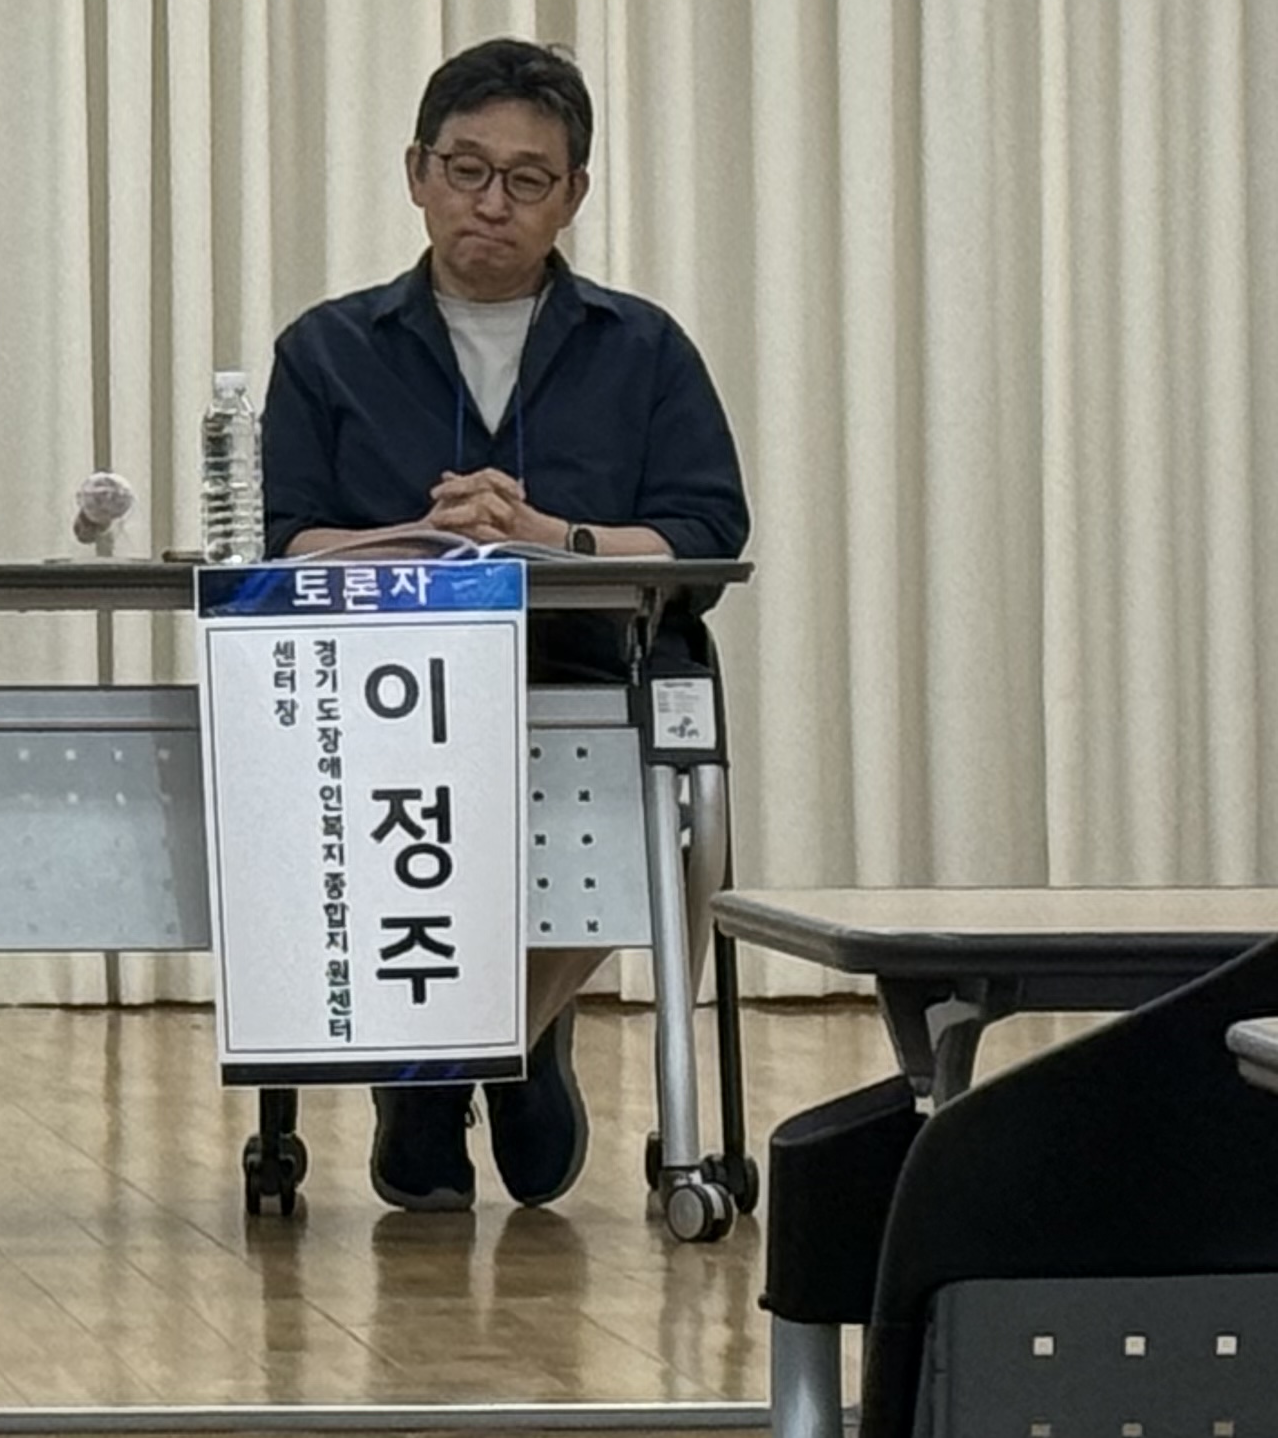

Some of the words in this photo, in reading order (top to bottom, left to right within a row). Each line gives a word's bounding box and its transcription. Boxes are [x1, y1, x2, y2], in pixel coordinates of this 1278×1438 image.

[293, 566, 431, 610] 토론자
[273, 640, 298, 726] 센터장
[364, 658, 460, 1005] 이정주
